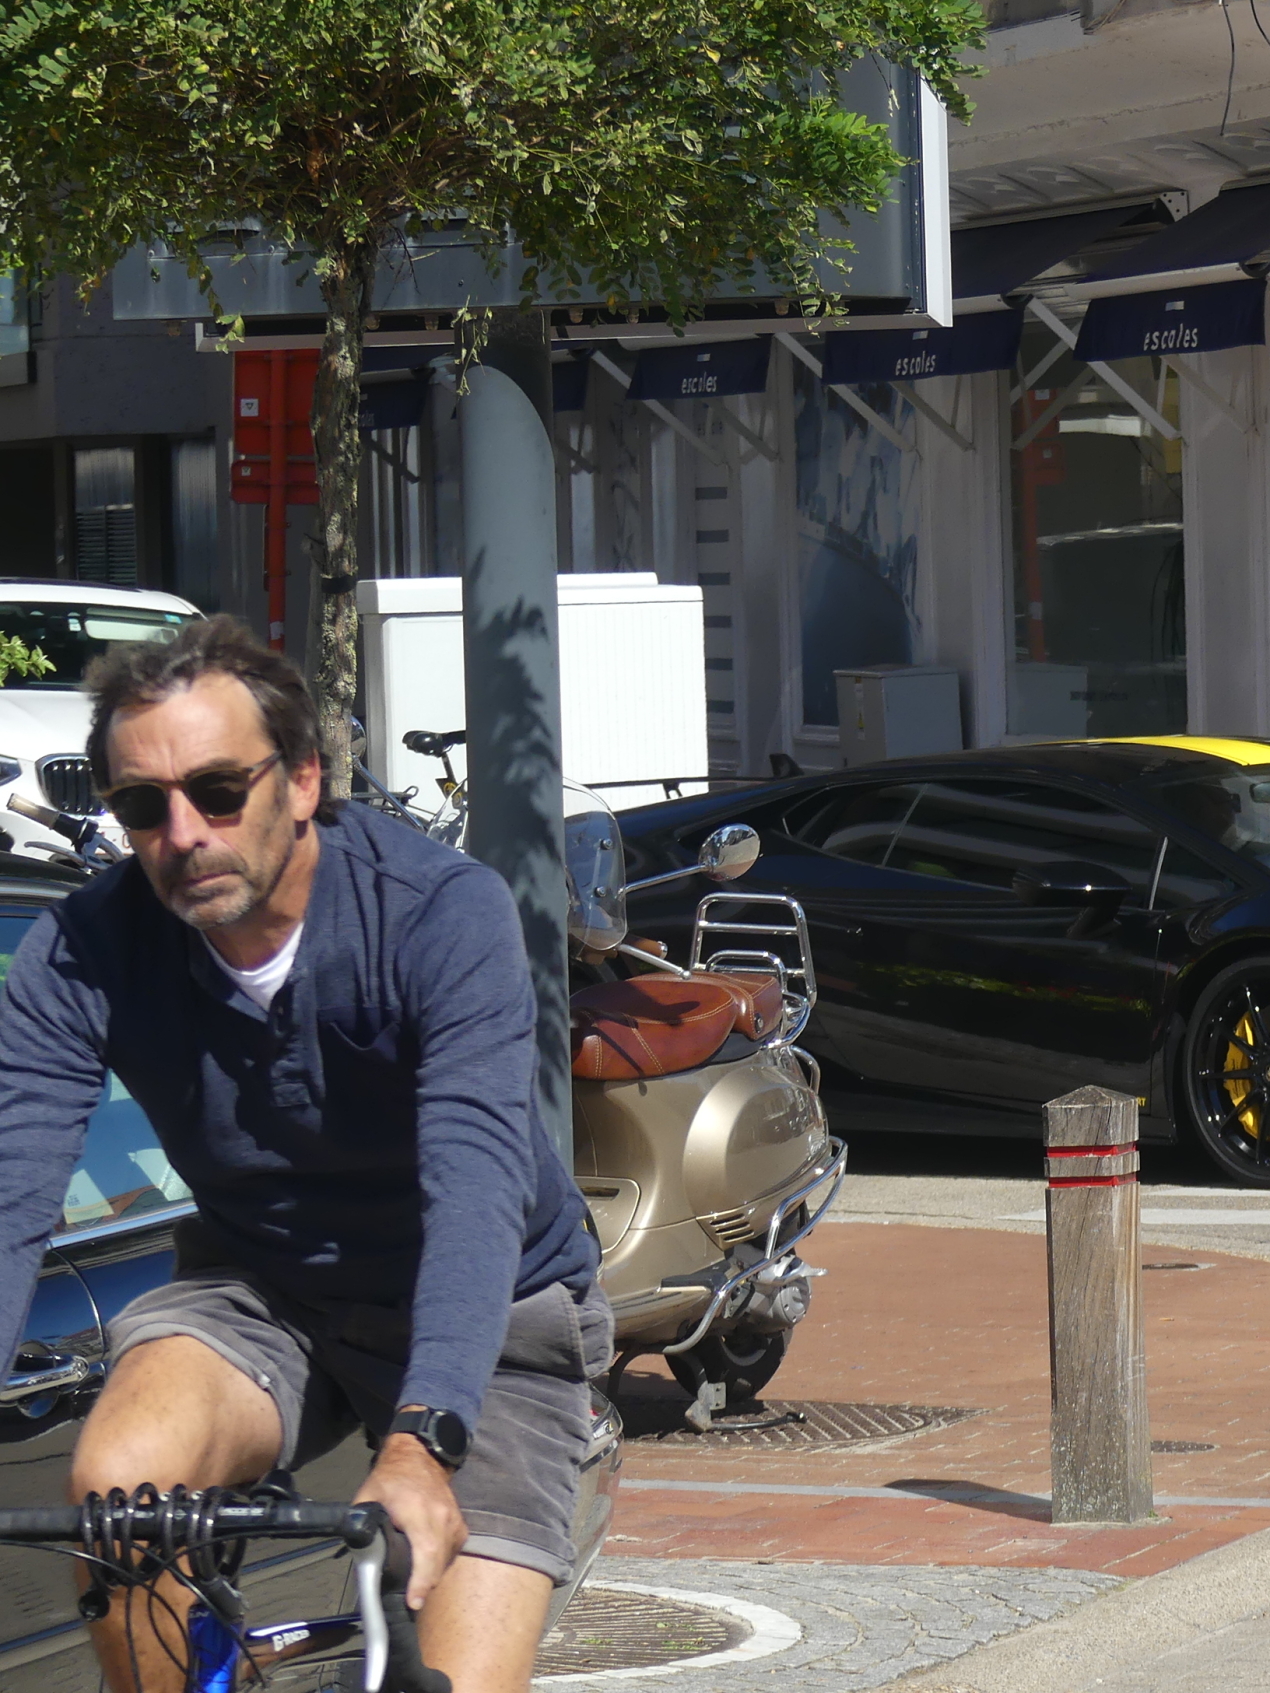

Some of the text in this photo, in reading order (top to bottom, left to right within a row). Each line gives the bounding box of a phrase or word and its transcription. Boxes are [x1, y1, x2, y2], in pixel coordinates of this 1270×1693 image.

[1143, 323, 1198, 351] escales
[895, 350, 936, 376] escales
[681, 371, 718, 394] escales
